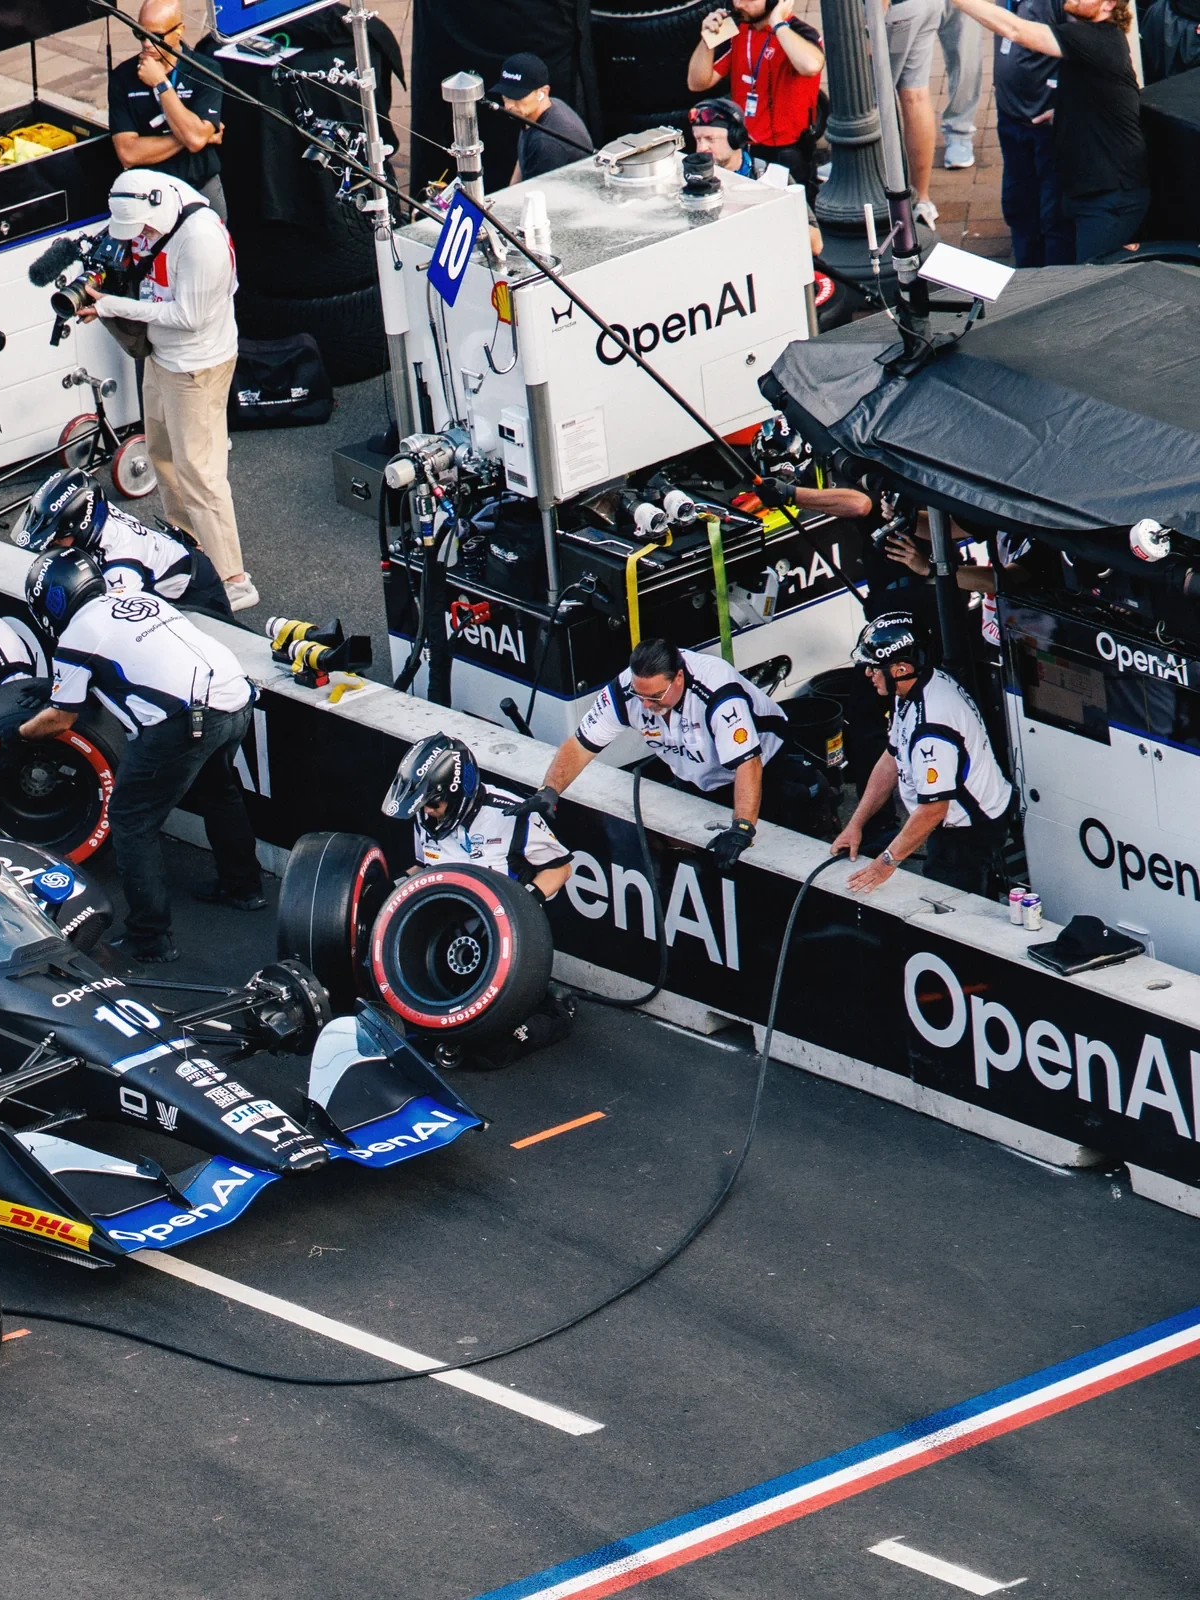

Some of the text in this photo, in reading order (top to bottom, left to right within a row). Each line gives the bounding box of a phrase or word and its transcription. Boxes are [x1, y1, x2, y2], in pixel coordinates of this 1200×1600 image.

[438, 204, 474, 280] 10
[596, 273, 757, 367] OpenAI
[50, 483, 78, 512] OpenAI
[80, 490, 95, 530] OpenAI
[33, 558, 53, 597] OpenAI
[445, 611, 526, 664] penAI
[876, 616, 913, 629] OpenAI
[875, 632, 915, 660] OpenAI
[1096, 632, 1189, 687] OpenAI
[416, 747, 443, 777] OpenAI
[450, 751, 461, 792] OpenAI
[386, 873, 444, 914] Firestone
[545, 850, 740, 971] enAI
[61, 905, 96, 936] restone
[52, 976, 126, 1008] OpenAI
[441, 985, 499, 1026] Firestone
[93, 998, 162, 1039] 10
[904, 951, 1200, 1142] OpenAI
[272, 1135, 315, 1153] Honda
[10, 1207, 79, 1243] DHL
[108, 1165, 255, 1244] OpenAI
